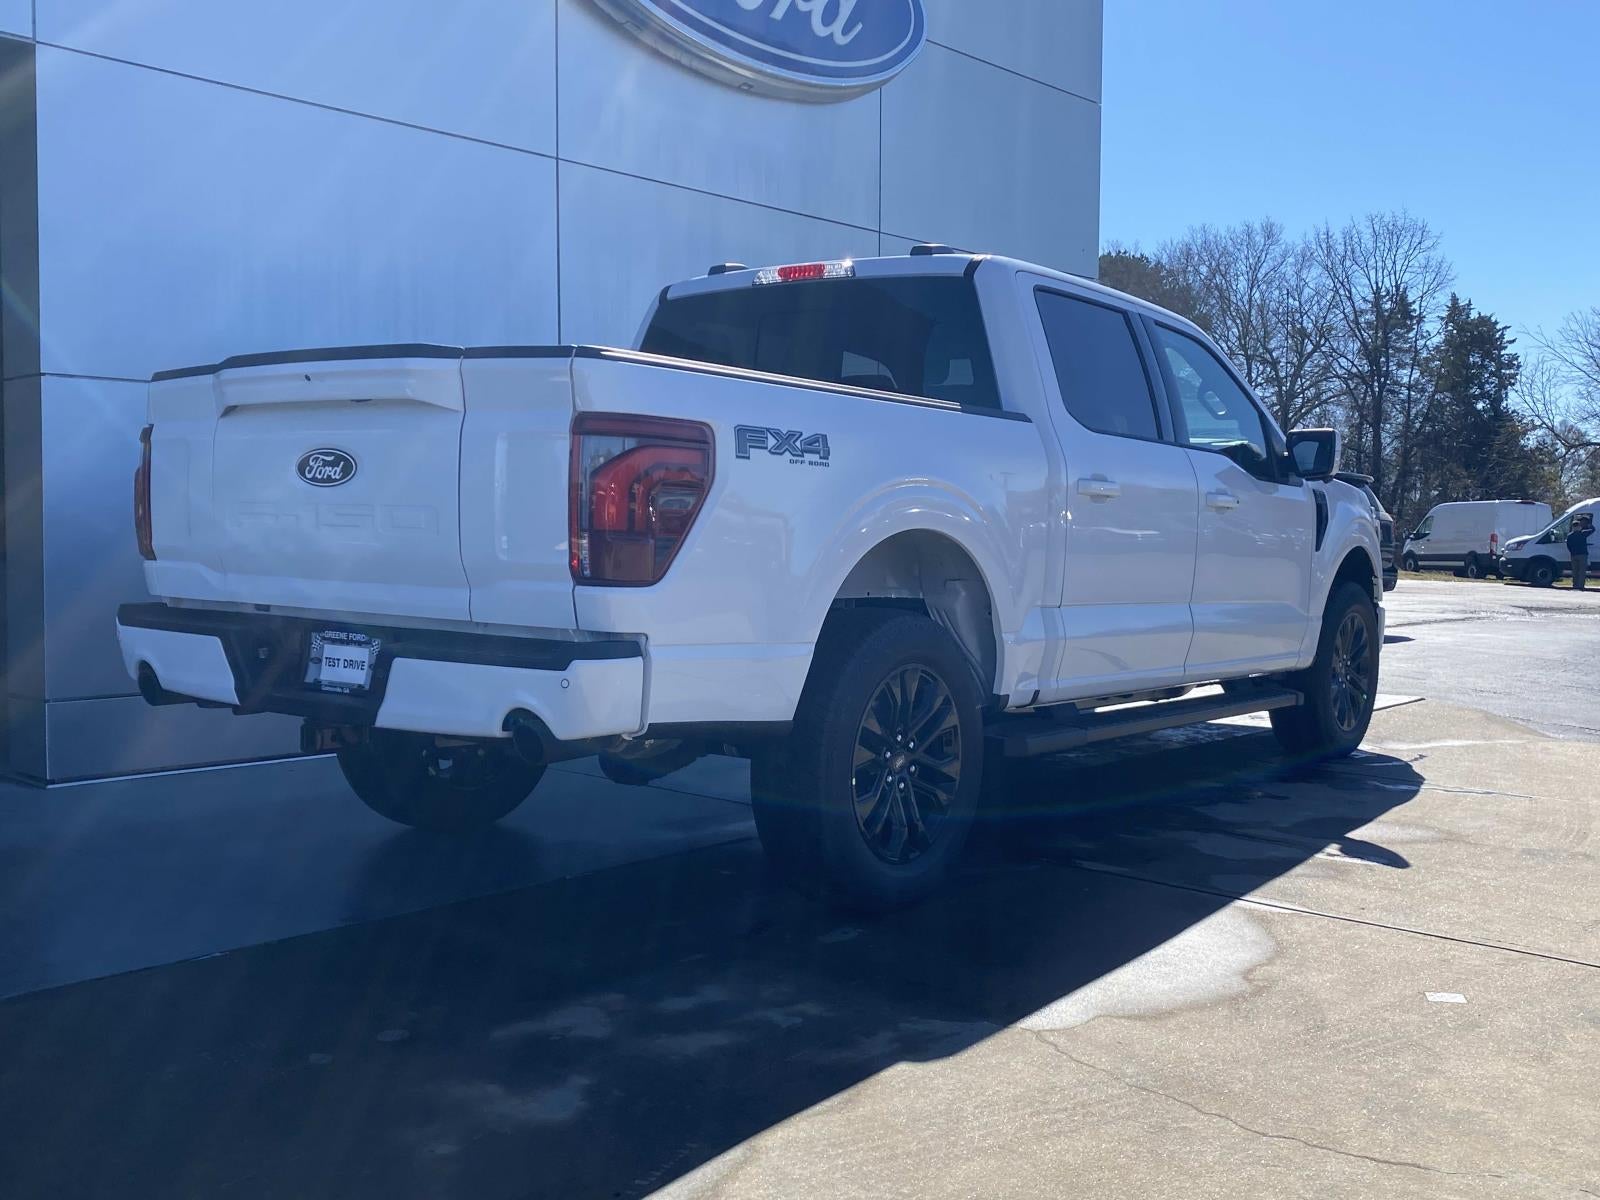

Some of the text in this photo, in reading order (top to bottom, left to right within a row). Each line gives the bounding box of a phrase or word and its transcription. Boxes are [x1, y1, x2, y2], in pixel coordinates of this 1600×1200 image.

[734, 425, 830, 460] FX4
[305, 454, 344, 479] Ford
[808, 460, 830, 468] ROAD
[349, 633, 366, 641] FORD
[325, 657, 366, 671] TEST DRIVE
